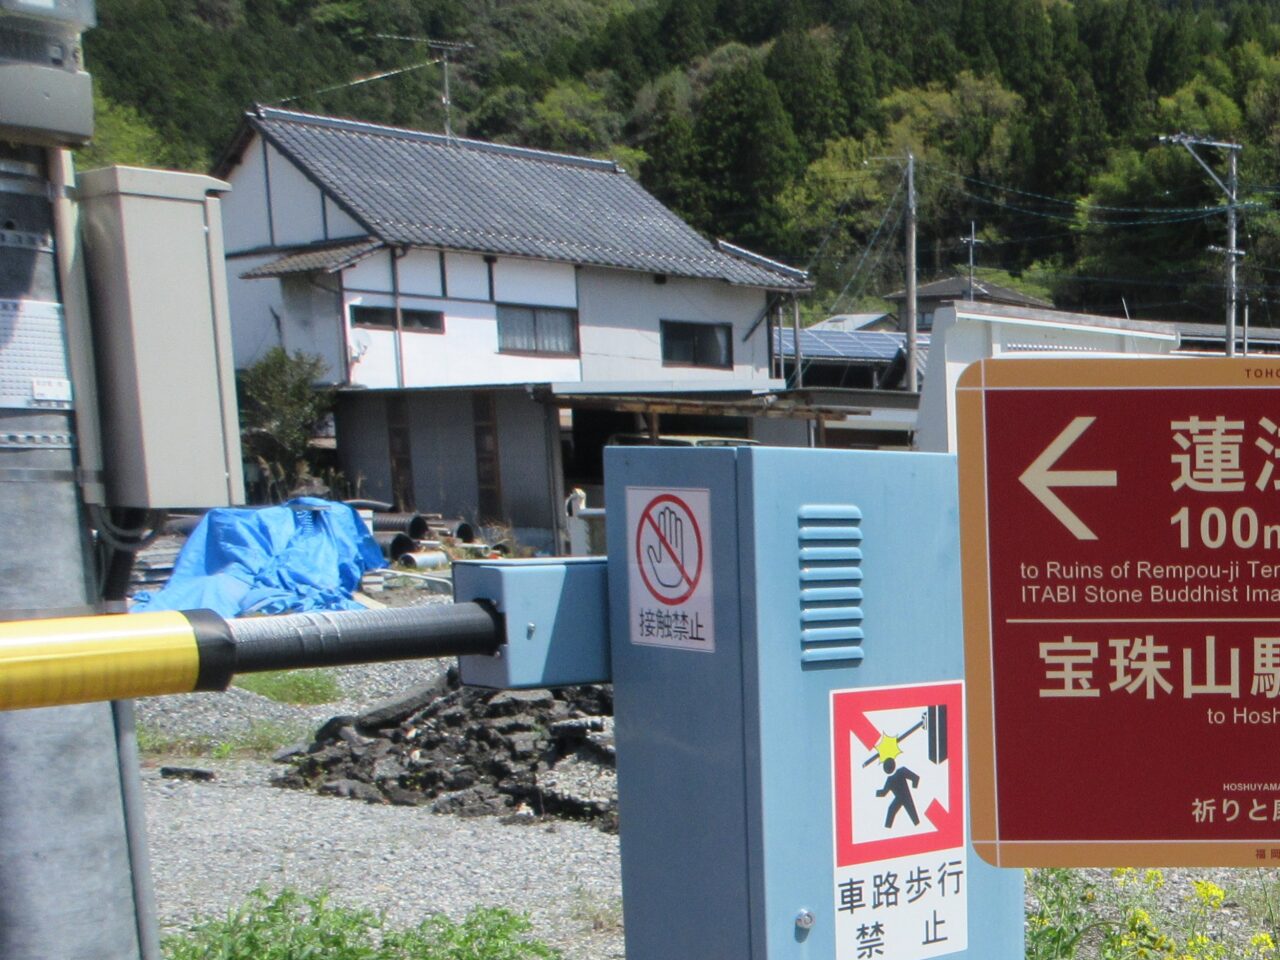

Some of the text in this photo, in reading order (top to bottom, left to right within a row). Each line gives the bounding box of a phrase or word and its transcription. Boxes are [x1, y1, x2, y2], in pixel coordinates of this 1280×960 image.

[1020, 562, 1039, 579] to
[1046, 561, 1104, 579] Ruins
[1110, 561, 1131, 579] of
[1137, 560, 1240, 583] Rempou-ji
[1021, 585, 1077, 603] ITABI
[1084, 585, 1143, 603] Stone
[1150, 585, 1239, 603] Buddhist
[639, 608, 706, 641] 接触禁止
[1207, 708, 1226, 724] to
[838, 860, 965, 914] 車路歩行
